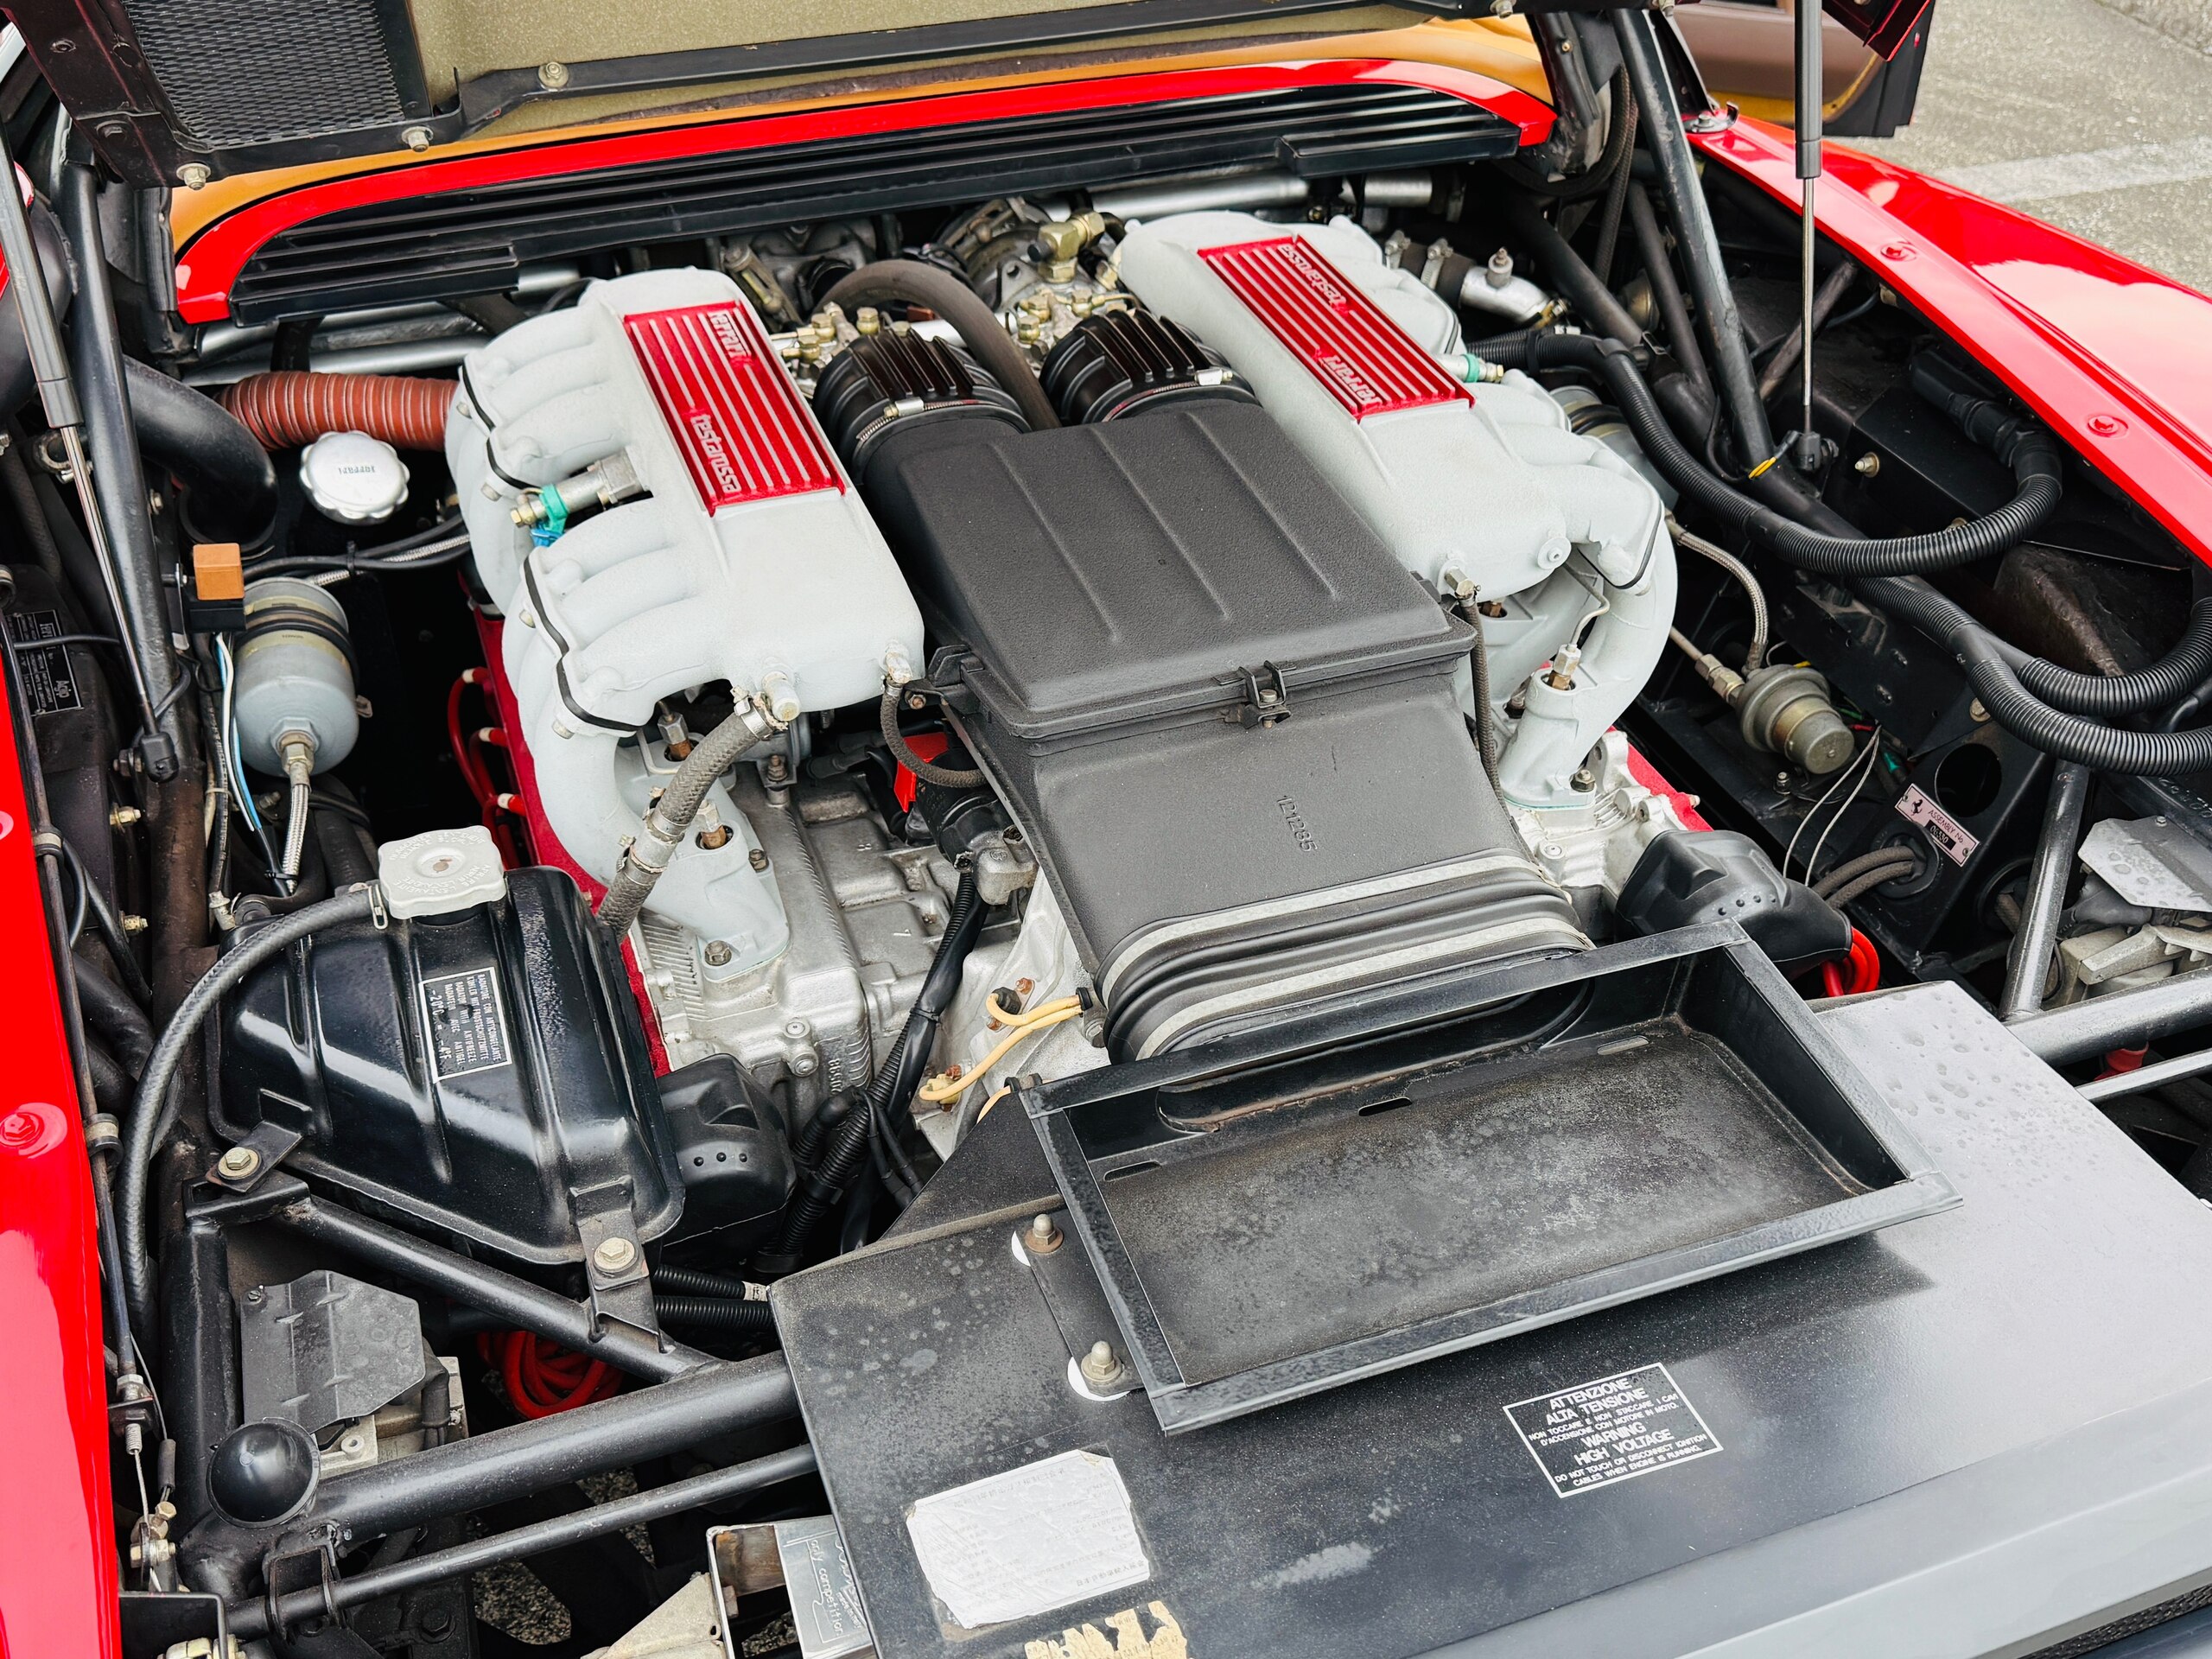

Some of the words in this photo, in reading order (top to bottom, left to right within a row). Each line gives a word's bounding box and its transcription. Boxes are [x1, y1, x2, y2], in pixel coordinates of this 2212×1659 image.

[54, 680, 72, 698] Agip
[1276, 797, 1319, 852] 121285
[1928, 809, 1956, 834] ASSEMBLY
[450, 1019, 461, 1033] AVEC
[454, 981, 467, 1004] RADIATOR
[463, 1030, 477, 1063] ANTIFREEZE
[454, 1041, 466, 1065] ANTIGEL
[1546, 1408, 1579, 1426] ALTA
[1579, 1388, 1649, 1415] TENSIONE
[1549, 1377, 1633, 1410] ATTENZIONE
[1529, 1431, 1547, 1441] NON
[1548, 1421, 1584, 1436] TOCCARE
[1595, 1413, 1612, 1422] NON
[1616, 1400, 1655, 1415] STACCARE
[1540, 1427, 1595, 1447] D'ACCENSIONE
[1595, 1421, 1613, 1432] CON
[1614, 1411, 1645, 1427] MOTORE
[1655, 1402, 1680, 1414] MOTO.
[1580, 1421, 1647, 1449] WARNING
[1554, 1473, 1567, 1484] DO
[1570, 1468, 1586, 1479] NOT
[1586, 1461, 1612, 1474] TOUCH
[1613, 1456, 1627, 1465] OR
[1627, 1444, 1674, 1462] DISCONNECT
[1675, 1433, 1708, 1449] IGNITION
[1573, 1446, 1611, 1467] HIGH
[1611, 1428, 1675, 1455] VOLTAGE
[1573, 1473, 1604, 1487] CABLES
[1605, 1466, 1628, 1478] WHEN
[1629, 1458, 1656, 1471] ENGINE
[1656, 1455, 1666, 1464] IS
[810, 1539, 823, 1562] only
